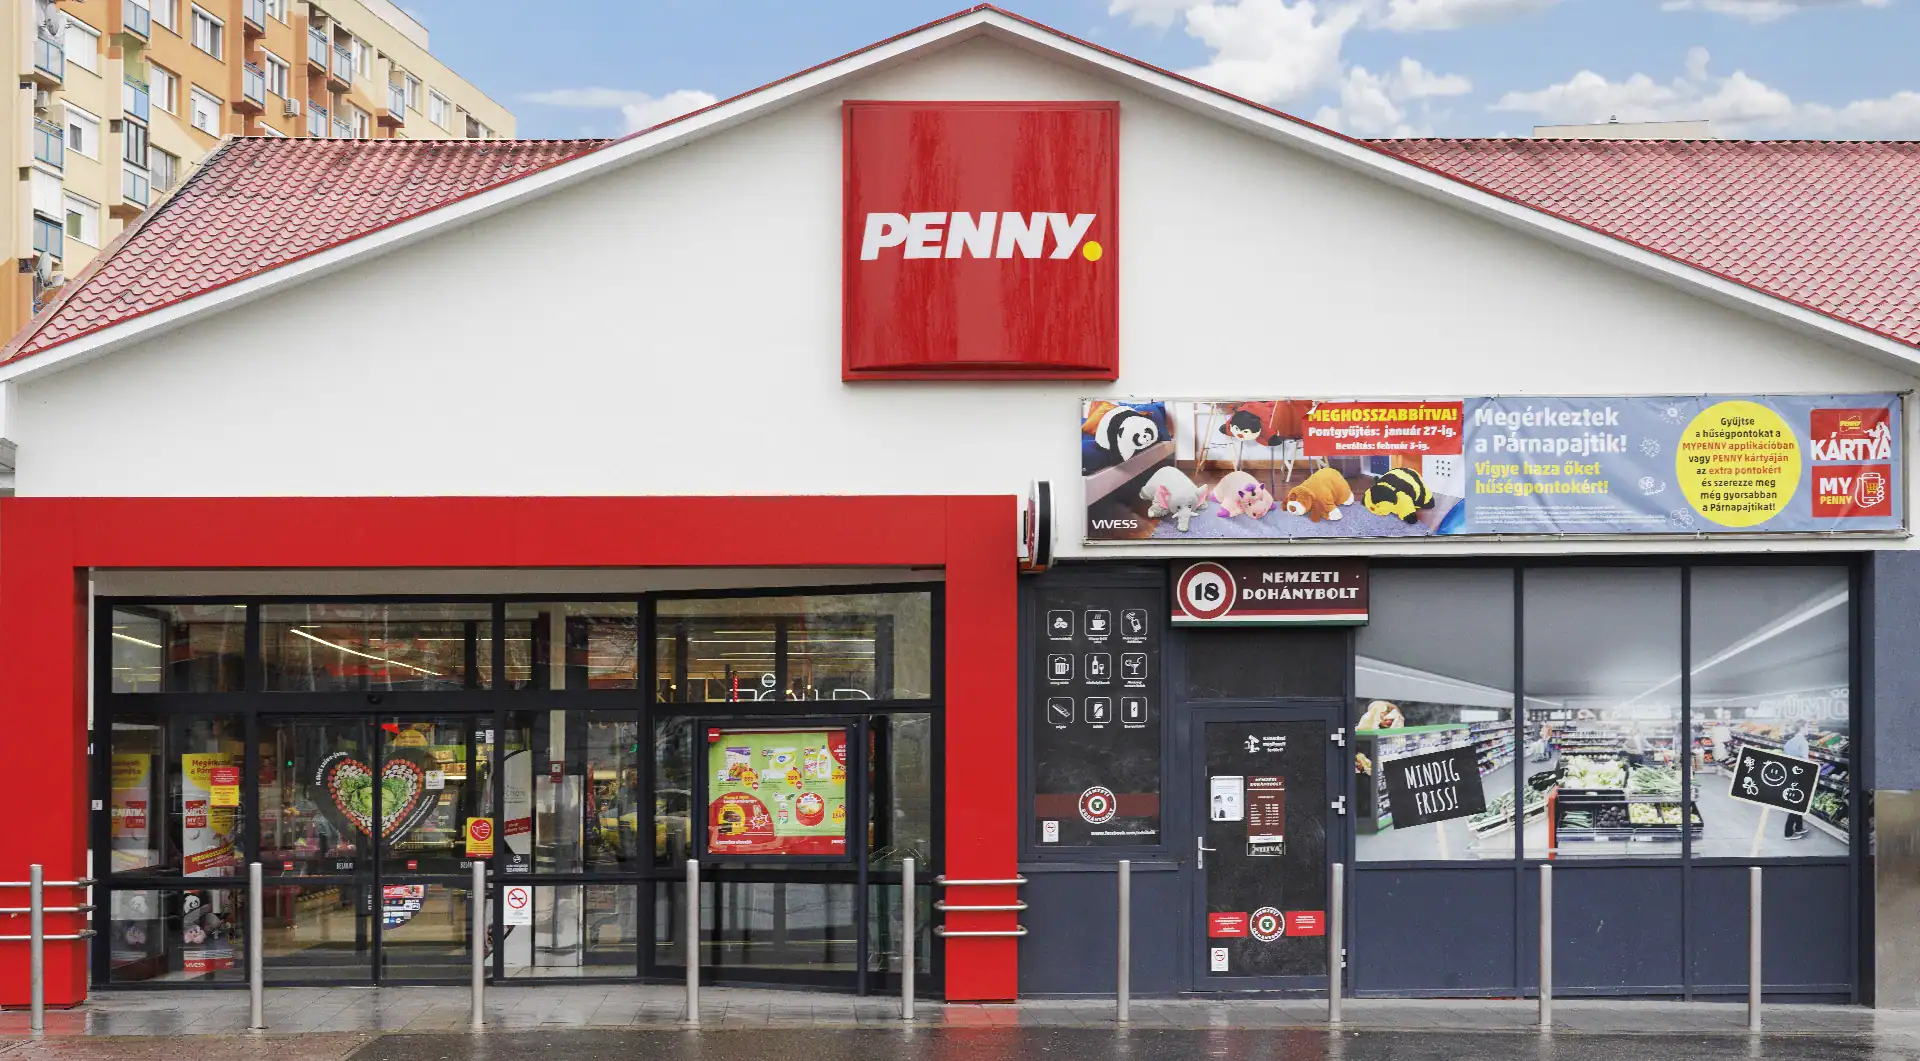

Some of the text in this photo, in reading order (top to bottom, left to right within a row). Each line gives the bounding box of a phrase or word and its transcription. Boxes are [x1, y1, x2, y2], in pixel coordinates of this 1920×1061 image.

[1308, 405, 1458, 422] MEGHOSSZABBÍTVA!
[1474, 406, 1619, 430] Megérkeztek
[1720, 417, 1755, 427] Gyűjtse
[1308, 425, 1457, 439] Pontgyűjtés: január 27-ig.
[1695, 429, 1781, 440] a hűségpontokat a
[1335, 441, 1430, 451] Beváltás: február 3-ig.
[1475, 432, 1627, 457] a Párnapajtik!
[1682, 441, 1795, 452] MYPENNY applikációban
[1688, 453, 1789, 465] vagy PENNY kártyáján
[1475, 460, 1601, 478] Vigye haza őket
[1696, 466, 1782, 477] az extra pontokért
[1475, 478, 1609, 497] hűségpontokért!
[1701, 478, 1776, 488] és szerezze meg
[1819, 477, 1853, 495] MY
[1700, 489, 1777, 501] még gyorsabban
[1820, 495, 1853, 505] PENNY
[1702, 502, 1776, 513] a Párnapajtikat!
[1092, 519, 1139, 530] VIVESS
[1262, 571, 1340, 584] NEMZETI
[1194, 582, 1220, 602] 18
[1242, 585, 1360, 600] DOHÁNYBOLT
[1404, 757, 1461, 790] MINDIG
[1415, 786, 1459, 816] FRISS!
